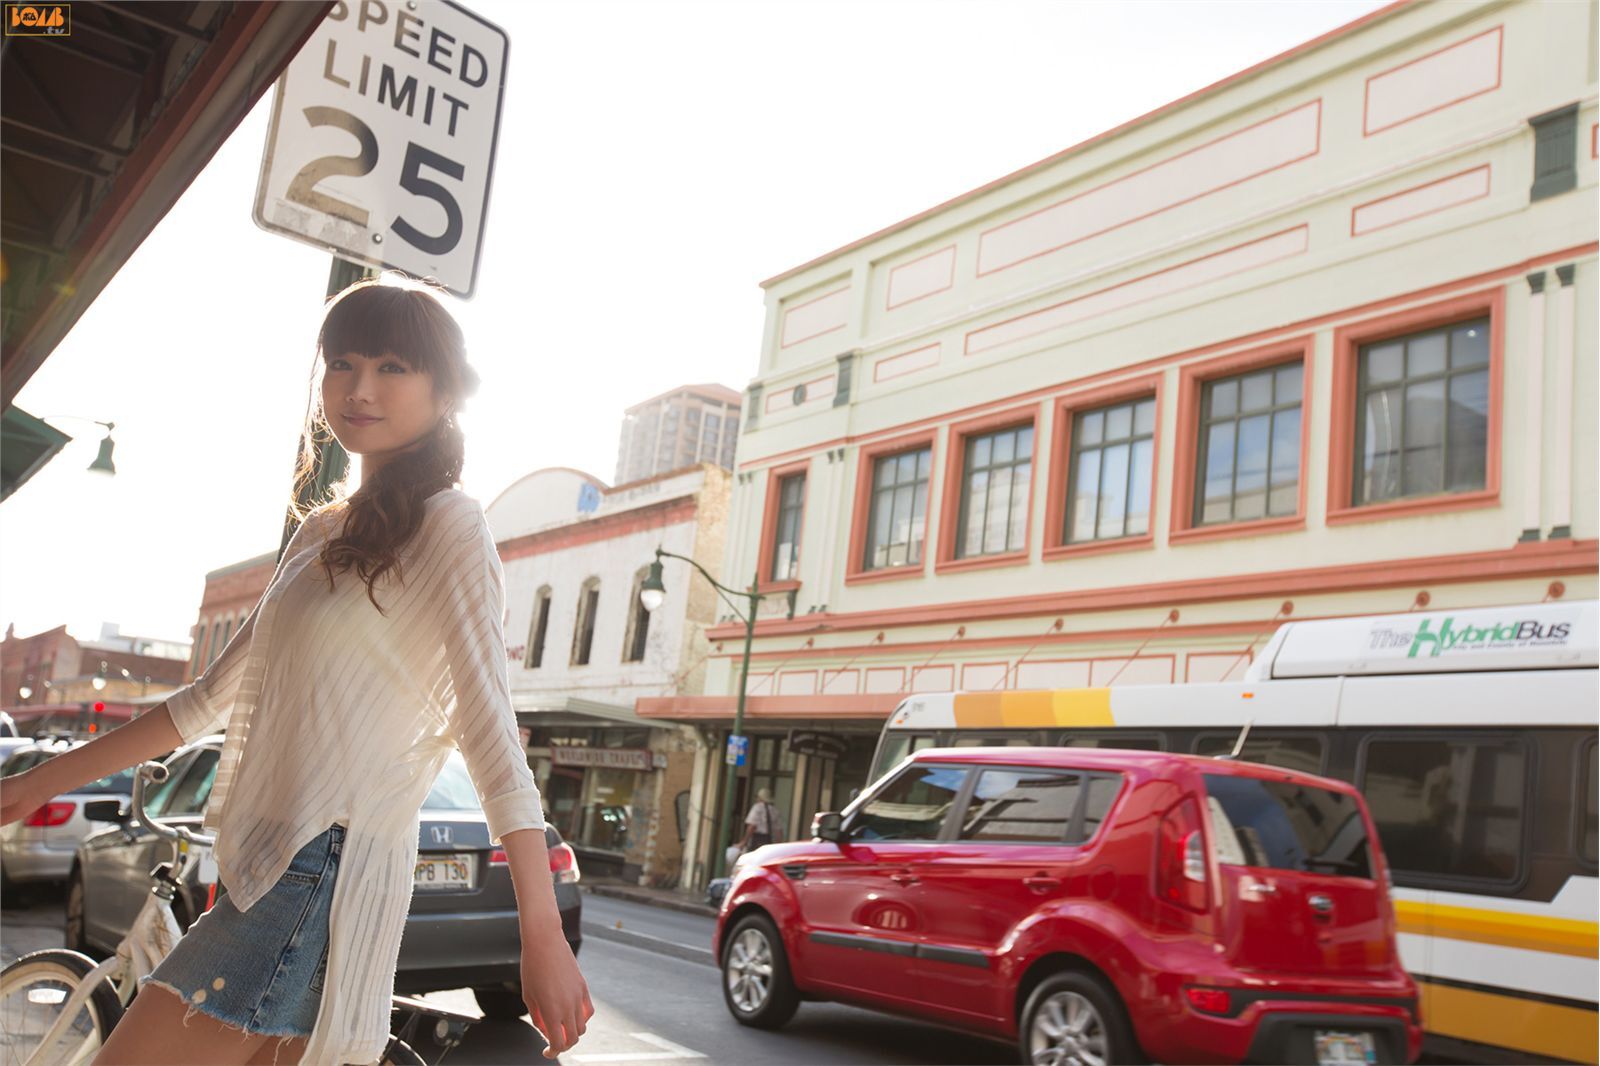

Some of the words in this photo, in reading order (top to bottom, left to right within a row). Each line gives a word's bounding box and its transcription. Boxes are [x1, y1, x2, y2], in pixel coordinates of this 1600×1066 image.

[323, 38, 470, 137] LIMIT
[285, 105, 465, 256] 25
[444, 863, 469, 881] 130
